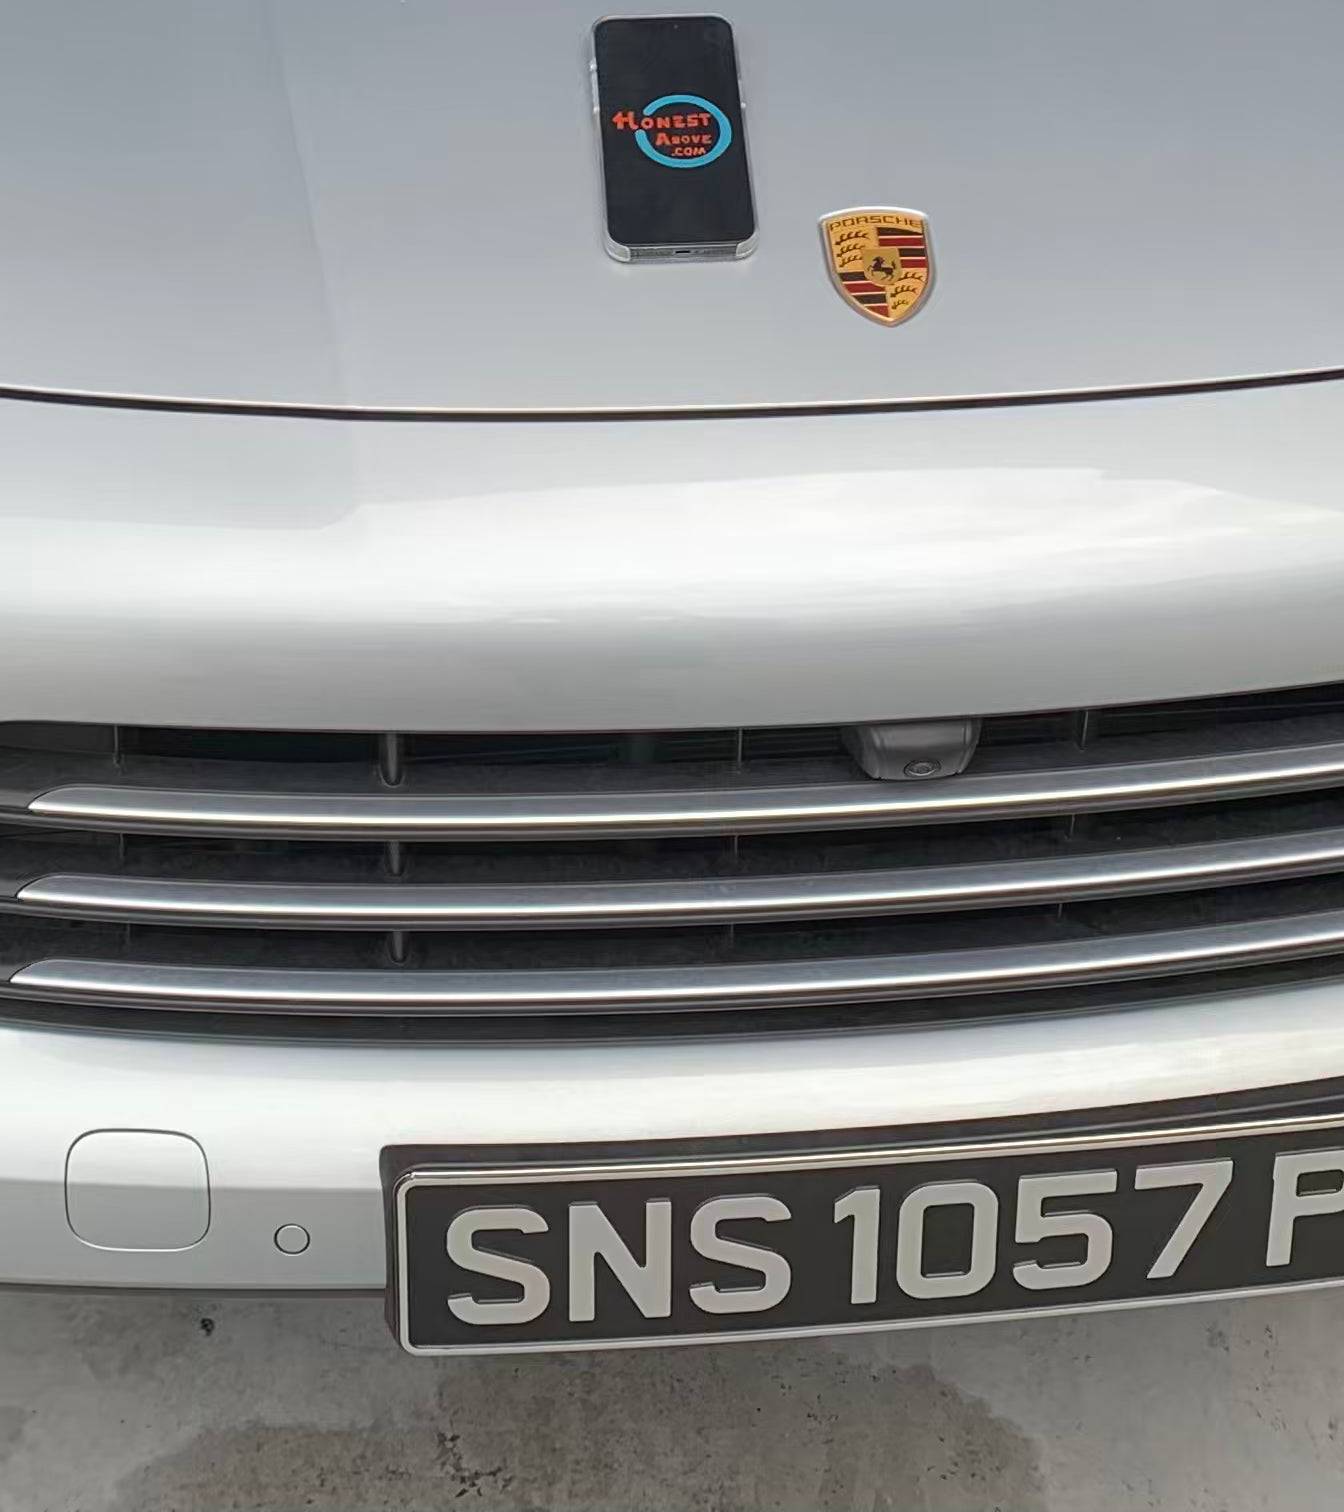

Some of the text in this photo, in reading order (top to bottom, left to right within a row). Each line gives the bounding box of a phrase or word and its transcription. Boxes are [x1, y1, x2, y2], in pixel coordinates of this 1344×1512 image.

[829, 215, 923, 231] PORSCHE
[445, 1193, 795, 1327] SNS
[830, 1159, 1237, 1307] 1057
